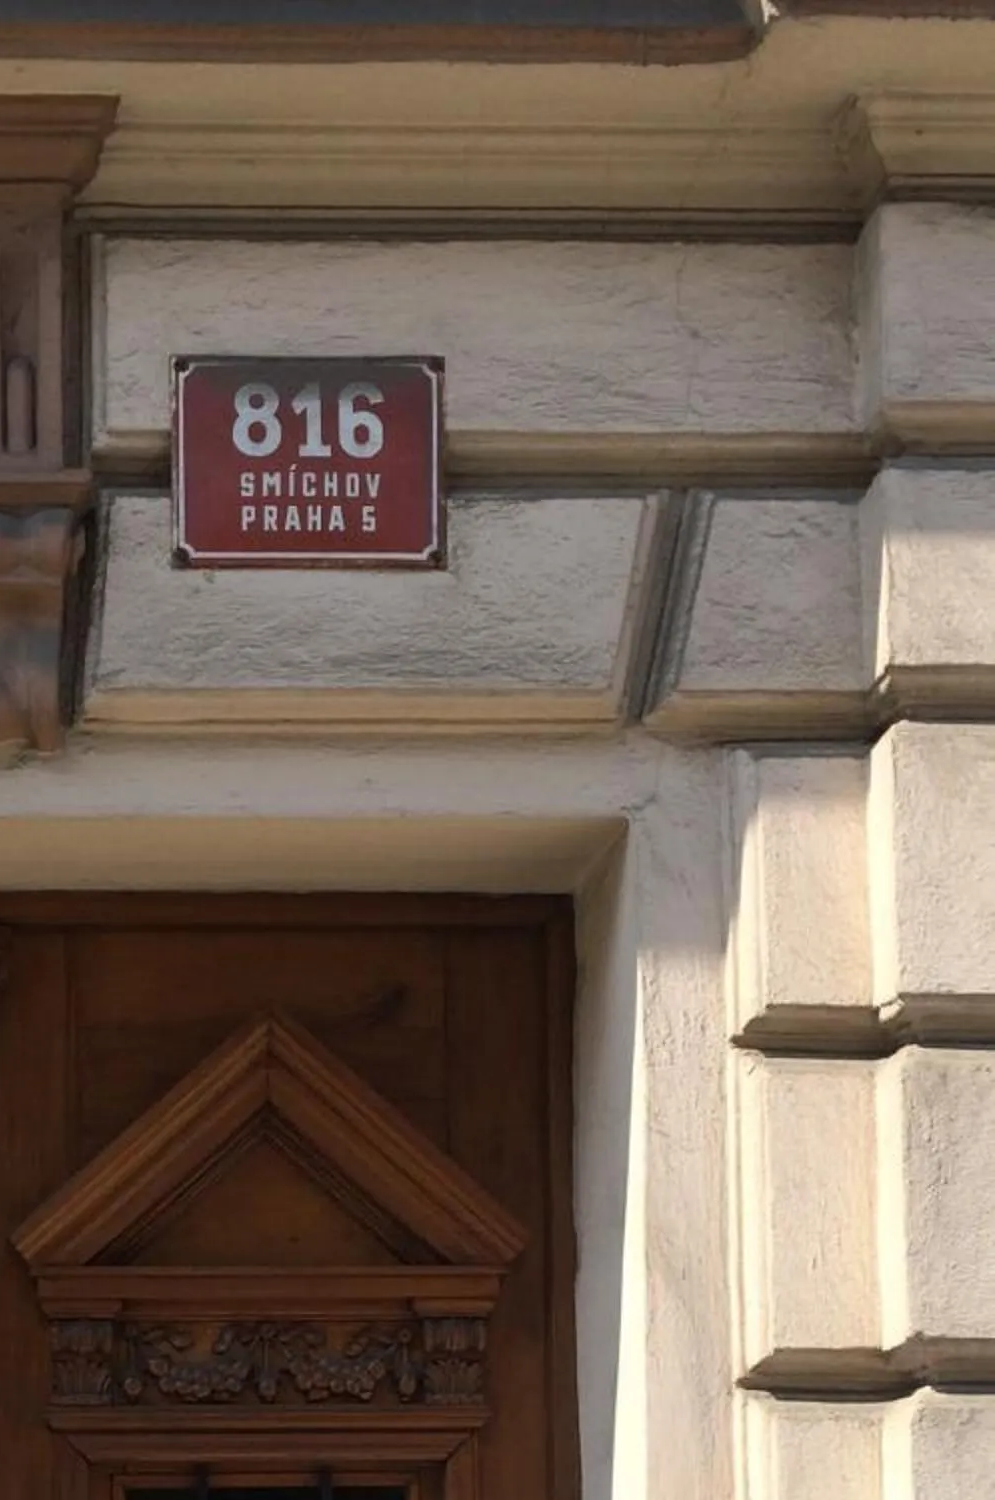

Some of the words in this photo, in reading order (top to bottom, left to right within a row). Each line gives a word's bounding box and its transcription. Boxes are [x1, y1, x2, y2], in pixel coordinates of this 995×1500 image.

[232, 382, 385, 458] 816
[240, 464, 381, 498] SMÍCHOV
[241, 505, 346, 532] PRAHA
[361, 505, 377, 532] 5
